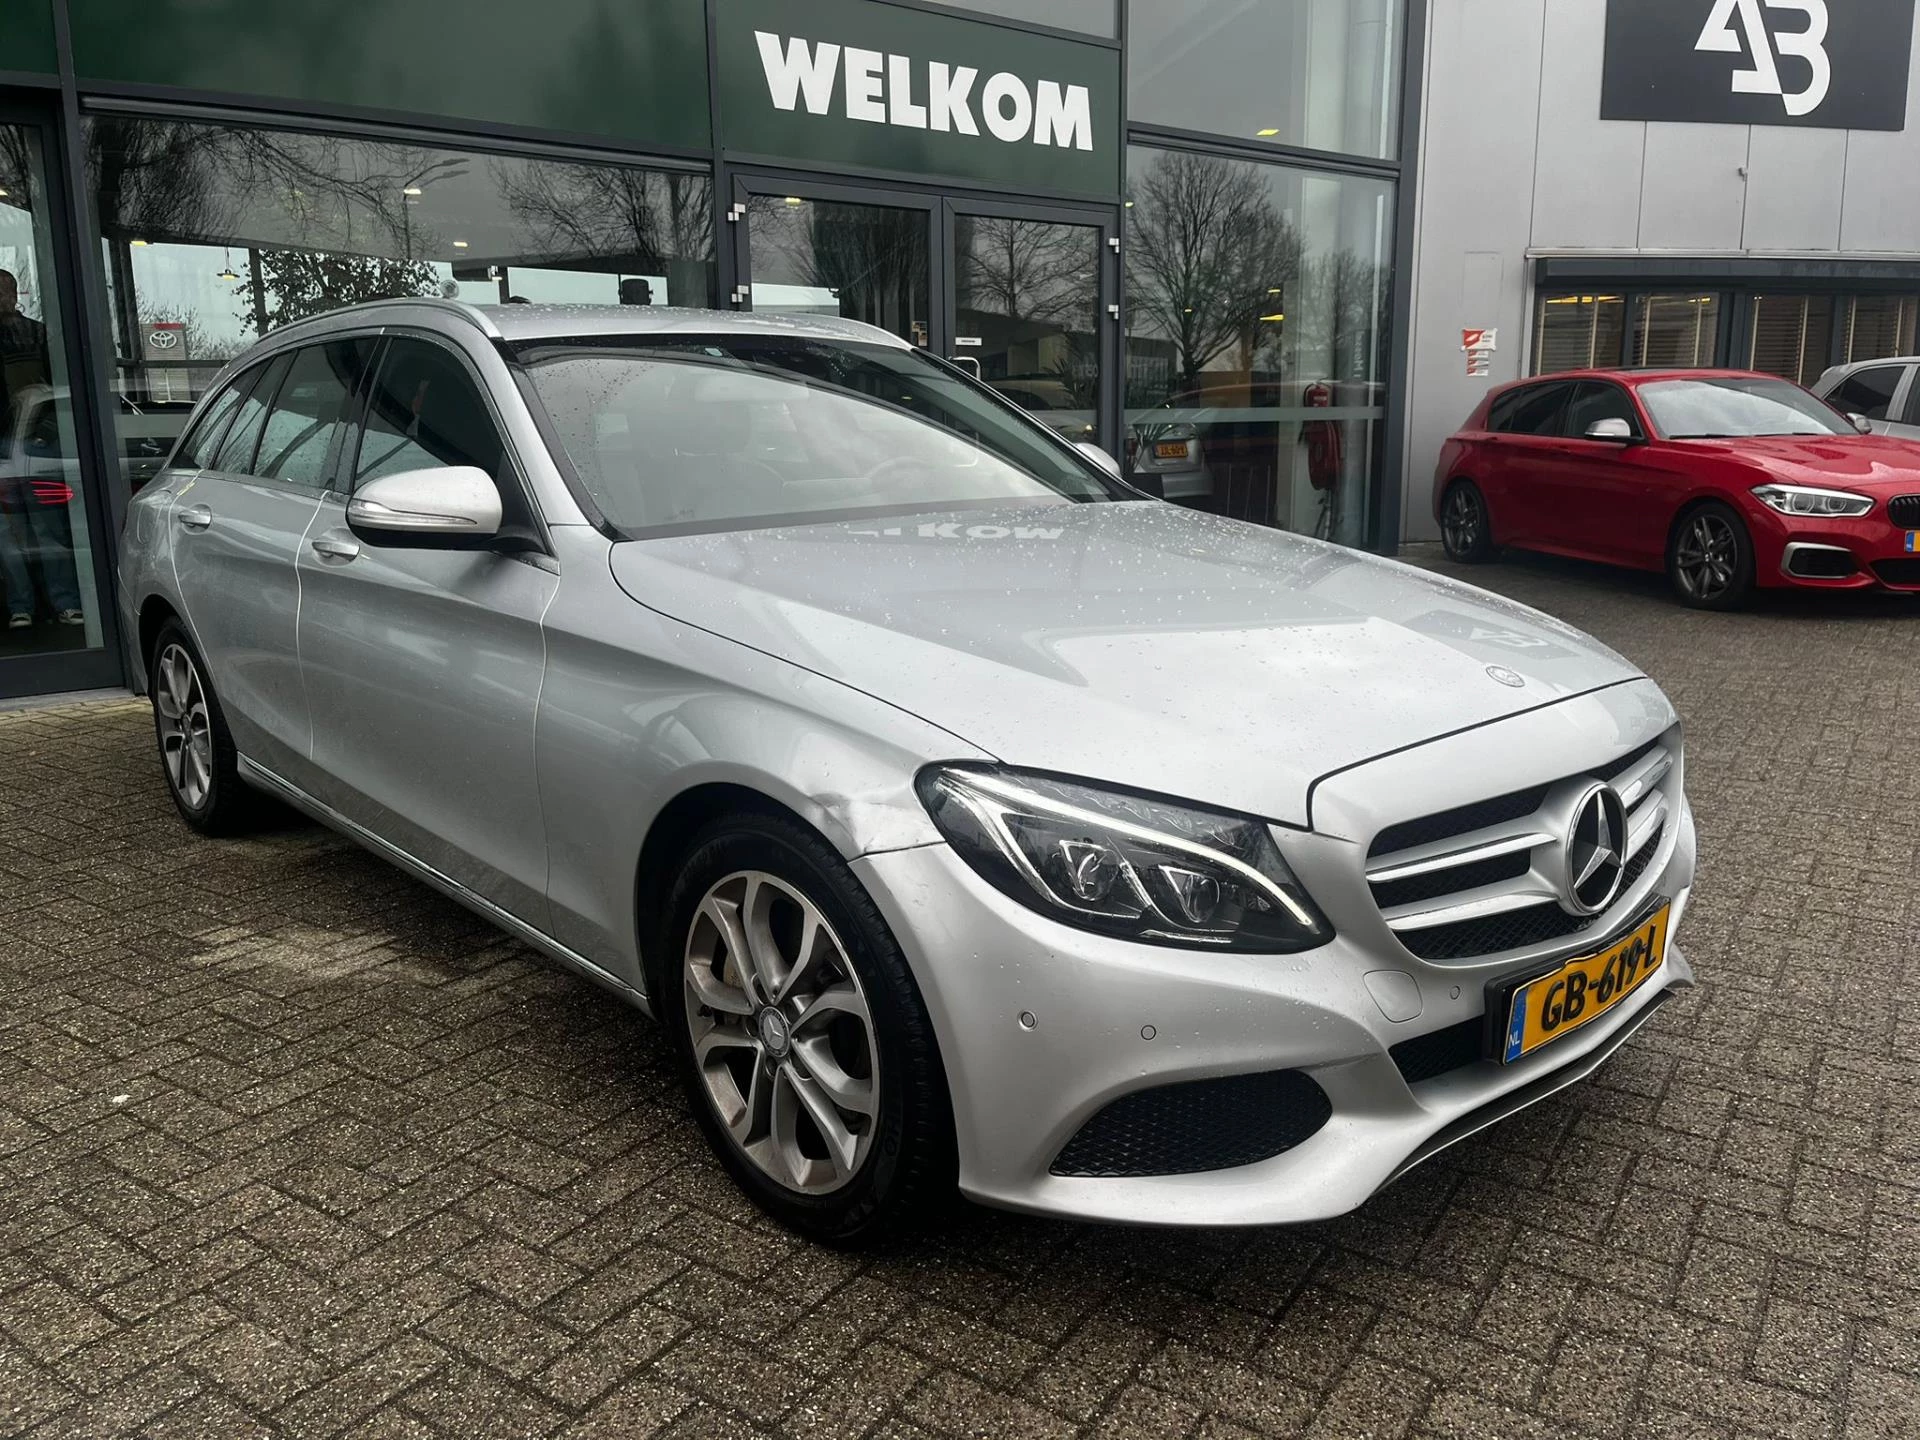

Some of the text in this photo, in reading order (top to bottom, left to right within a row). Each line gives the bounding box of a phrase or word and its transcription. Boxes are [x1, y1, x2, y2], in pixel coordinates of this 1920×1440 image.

[754, 30, 1093, 151] WELKOM
[1541, 924, 1657, 1032] GB-619-L
[1508, 1030, 1521, 1049] NL
